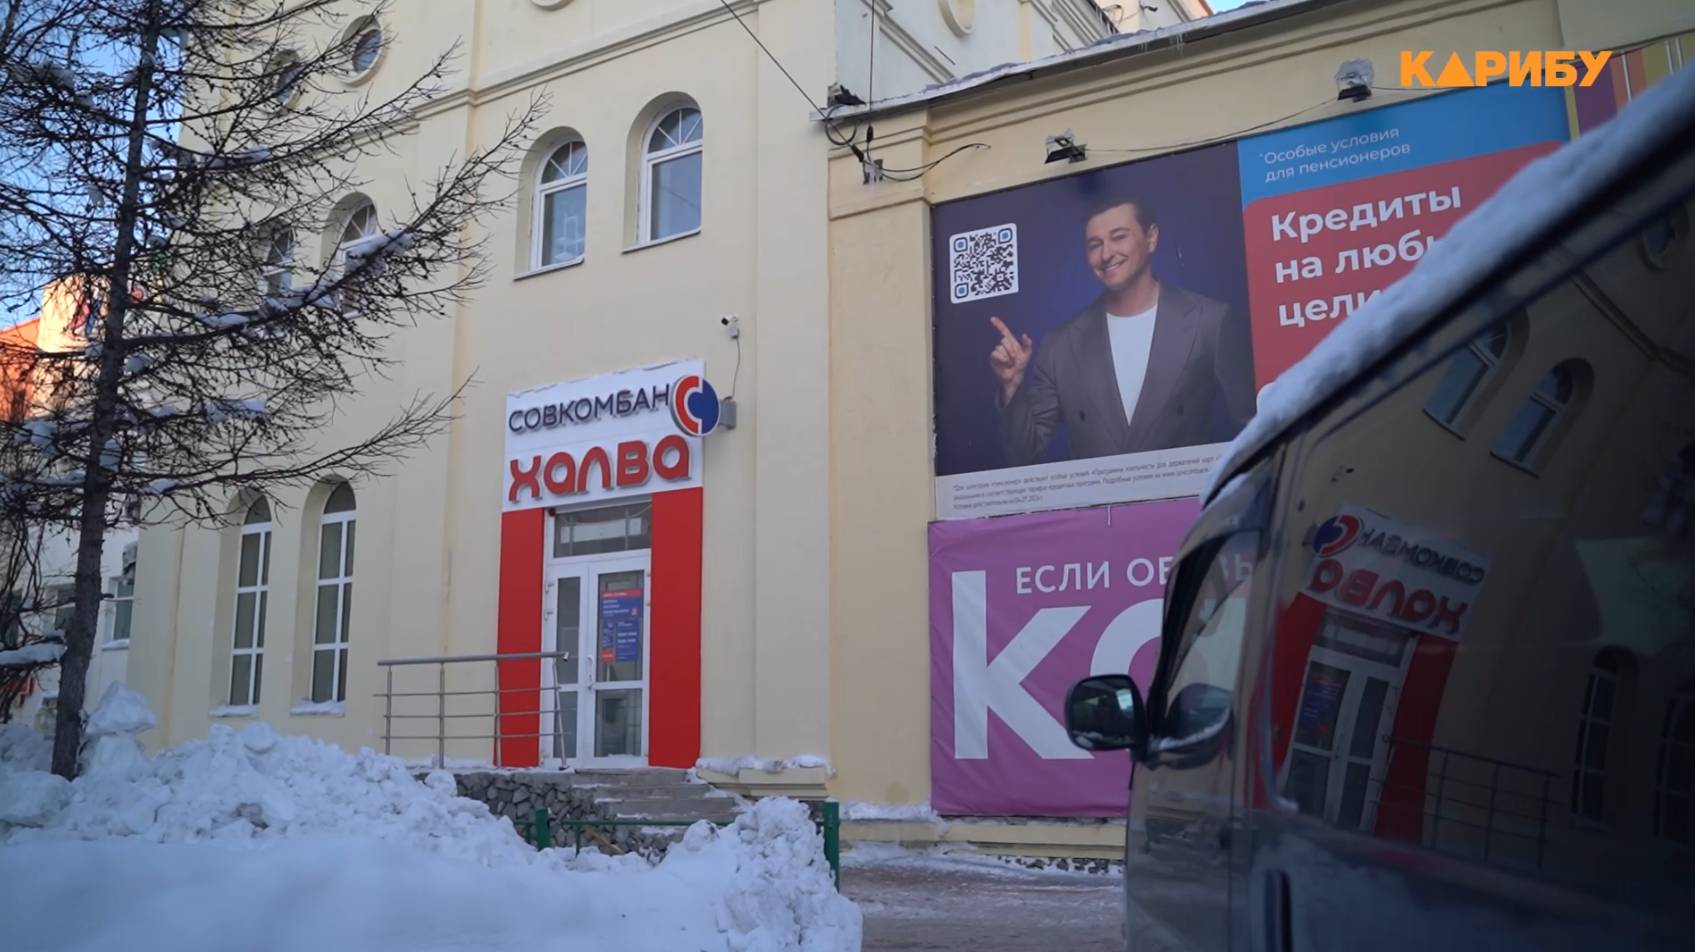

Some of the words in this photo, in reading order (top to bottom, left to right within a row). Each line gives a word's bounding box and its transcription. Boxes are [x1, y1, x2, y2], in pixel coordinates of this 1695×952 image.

[1330, 128, 1399, 152] условия
[1264, 168, 1295, 183] для
[1299, 143, 1411, 175] пенсионеров
[1271, 187, 1461, 243] Кредиты
[1275, 256, 1323, 283] на
[1016, 561, 1110, 594] ЕСЛИ
